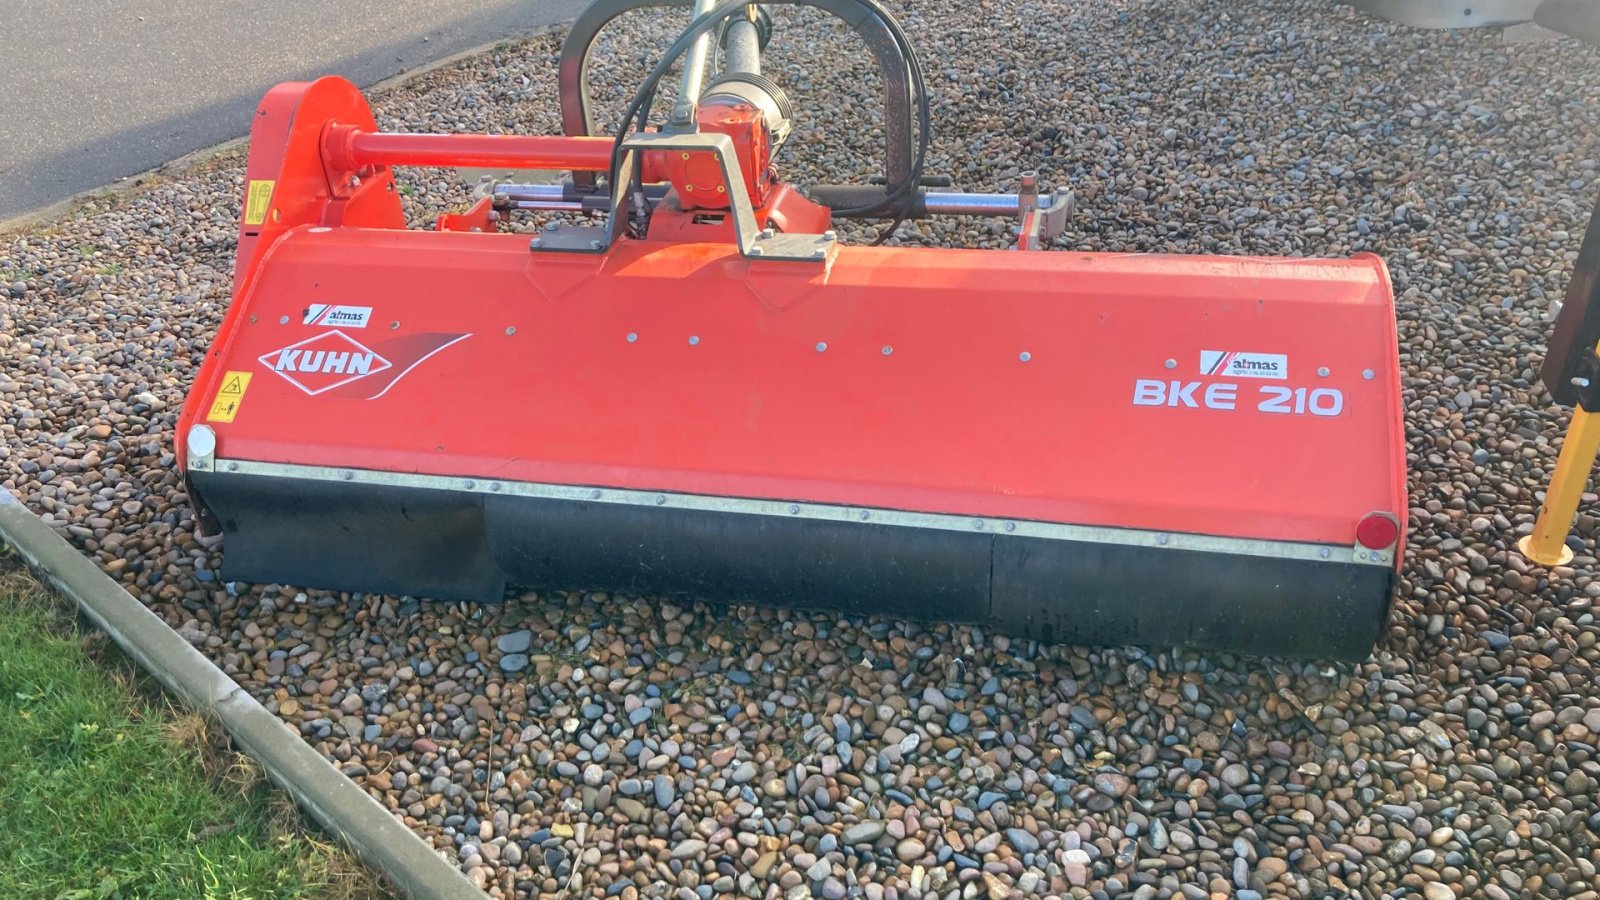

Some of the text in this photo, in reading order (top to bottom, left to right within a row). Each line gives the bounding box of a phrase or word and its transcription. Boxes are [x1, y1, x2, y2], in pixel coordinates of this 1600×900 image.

[329, 311, 363, 320] almas
[274, 349, 374, 375] KUHN
[1233, 359, 1278, 370] almas
[1132, 379, 1344, 416] BKE 210
